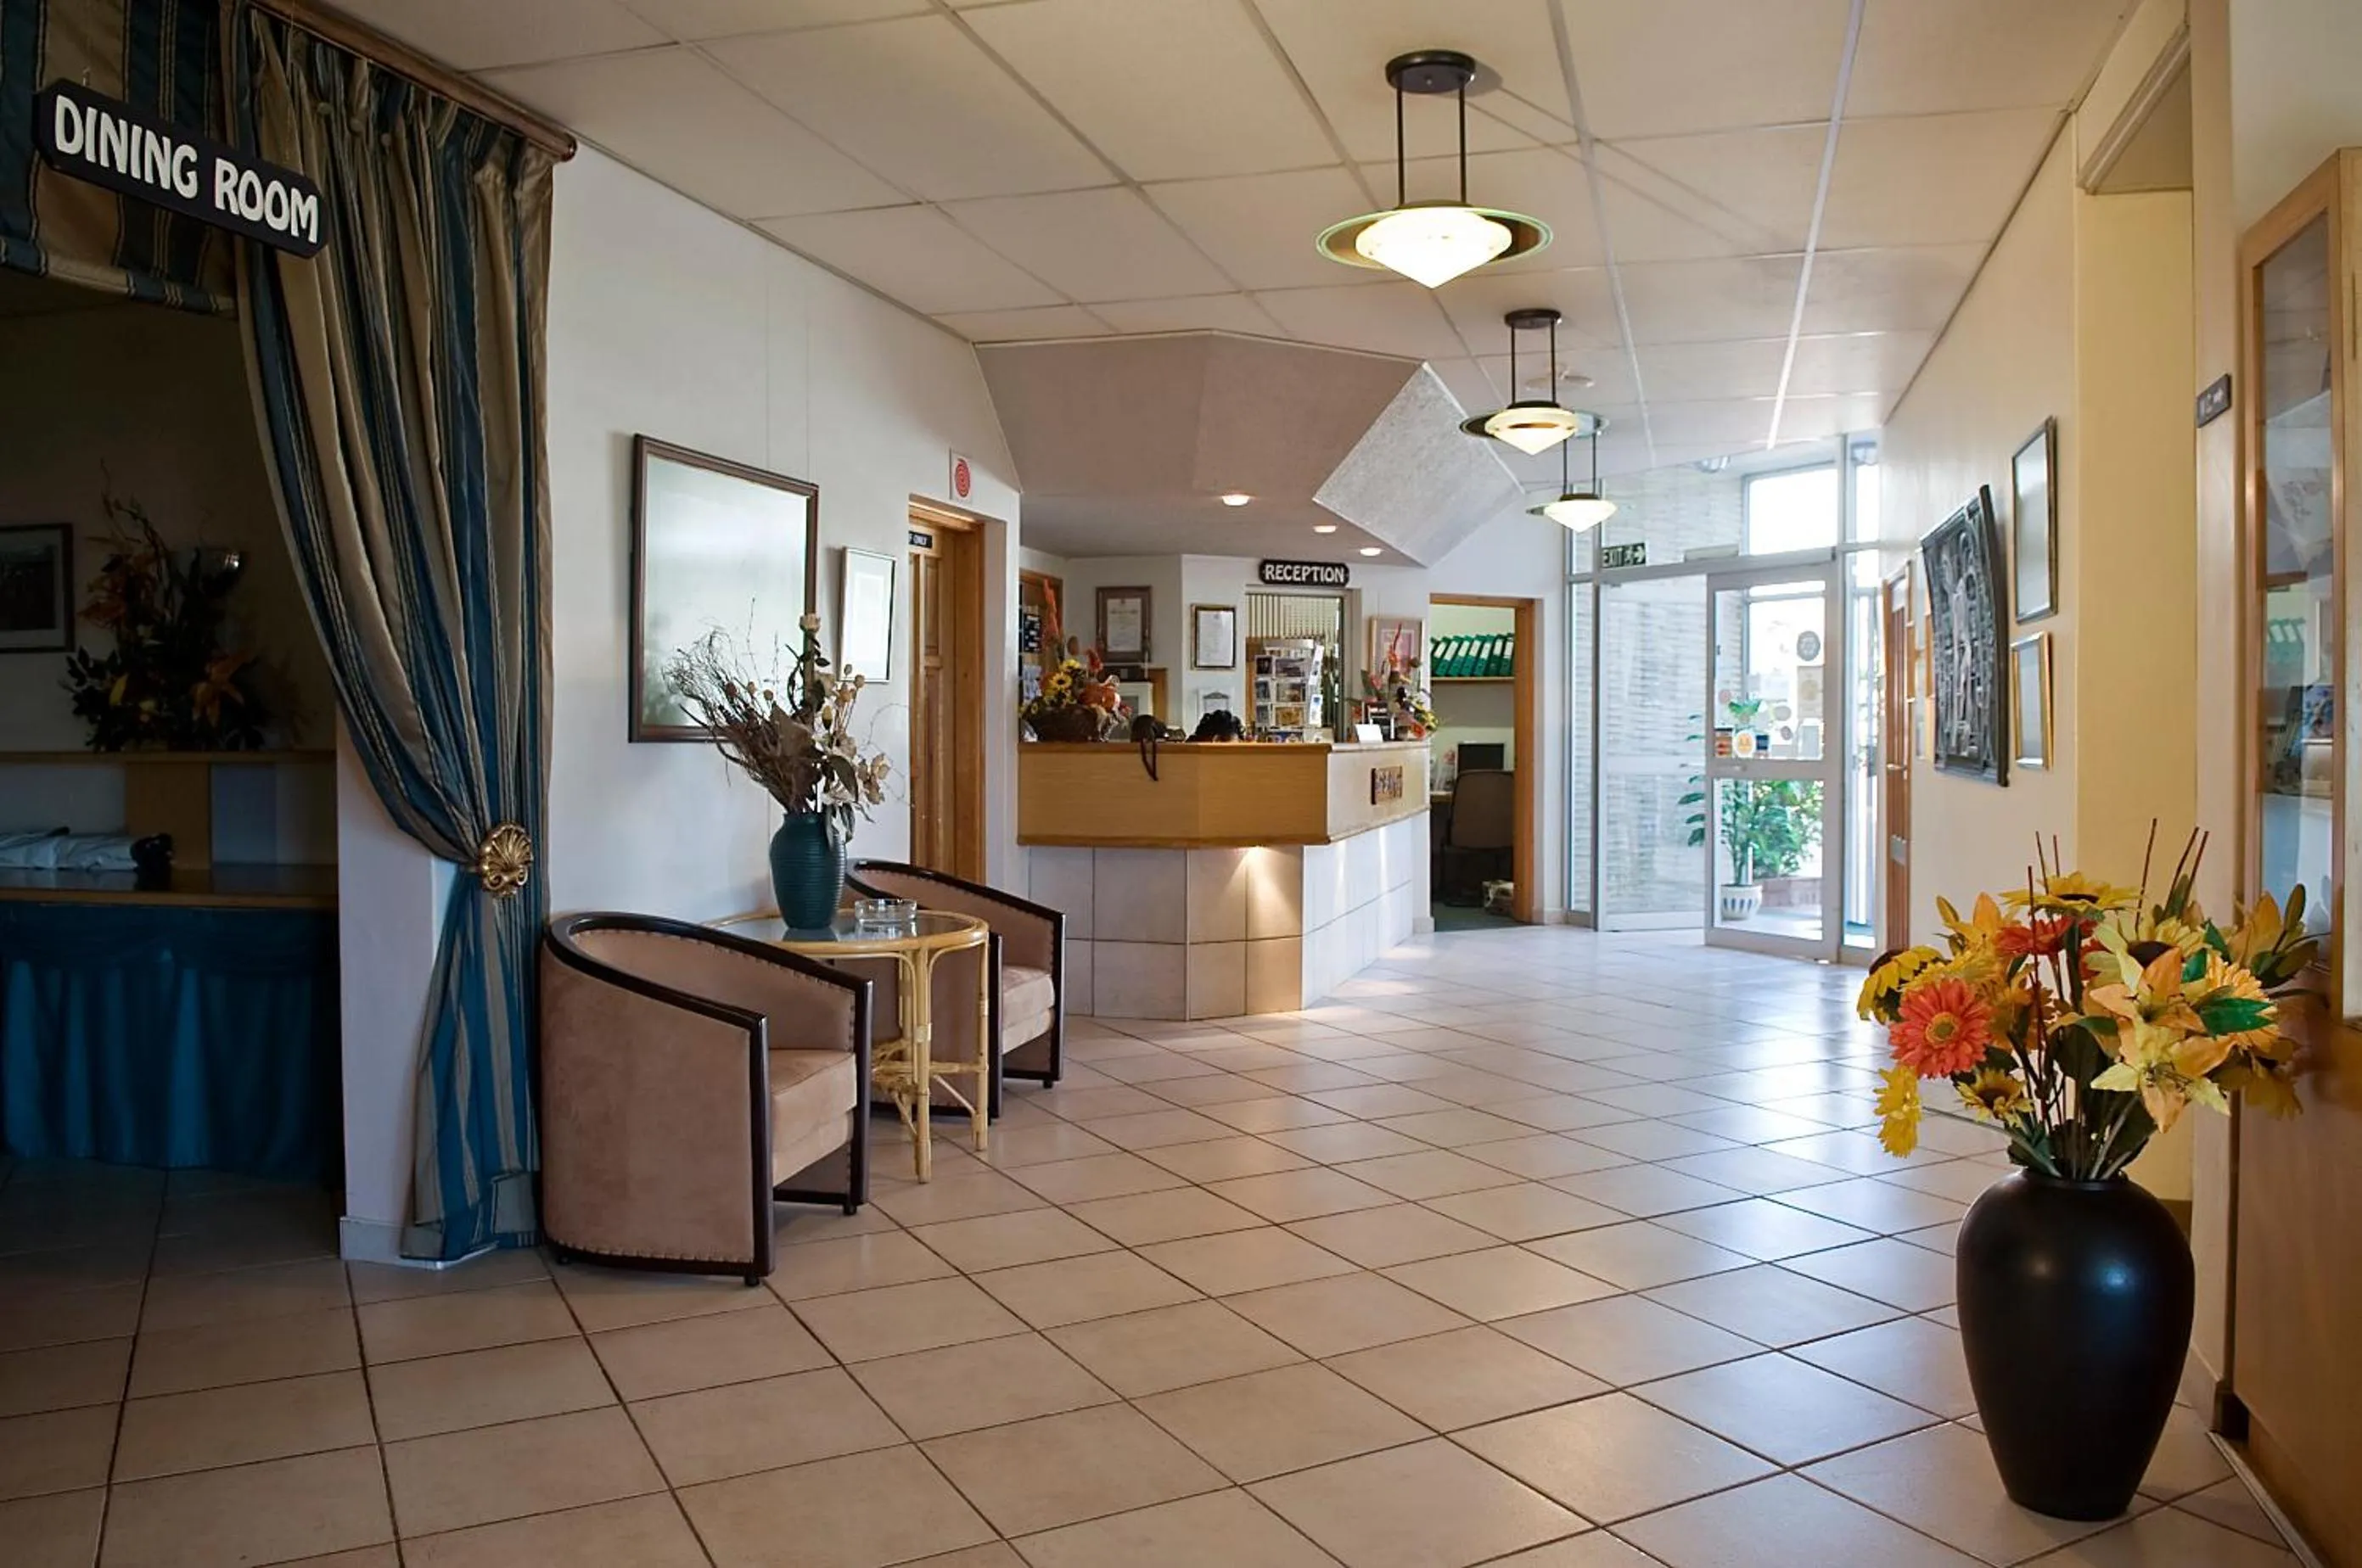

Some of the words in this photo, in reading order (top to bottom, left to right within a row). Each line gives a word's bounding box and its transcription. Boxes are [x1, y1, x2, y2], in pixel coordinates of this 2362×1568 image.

[54, 94, 199, 199] DINING
[215, 157, 319, 244] ROOM
[1602, 548, 1623, 567] EXIT
[1265, 563, 1345, 584] RECEPTION
